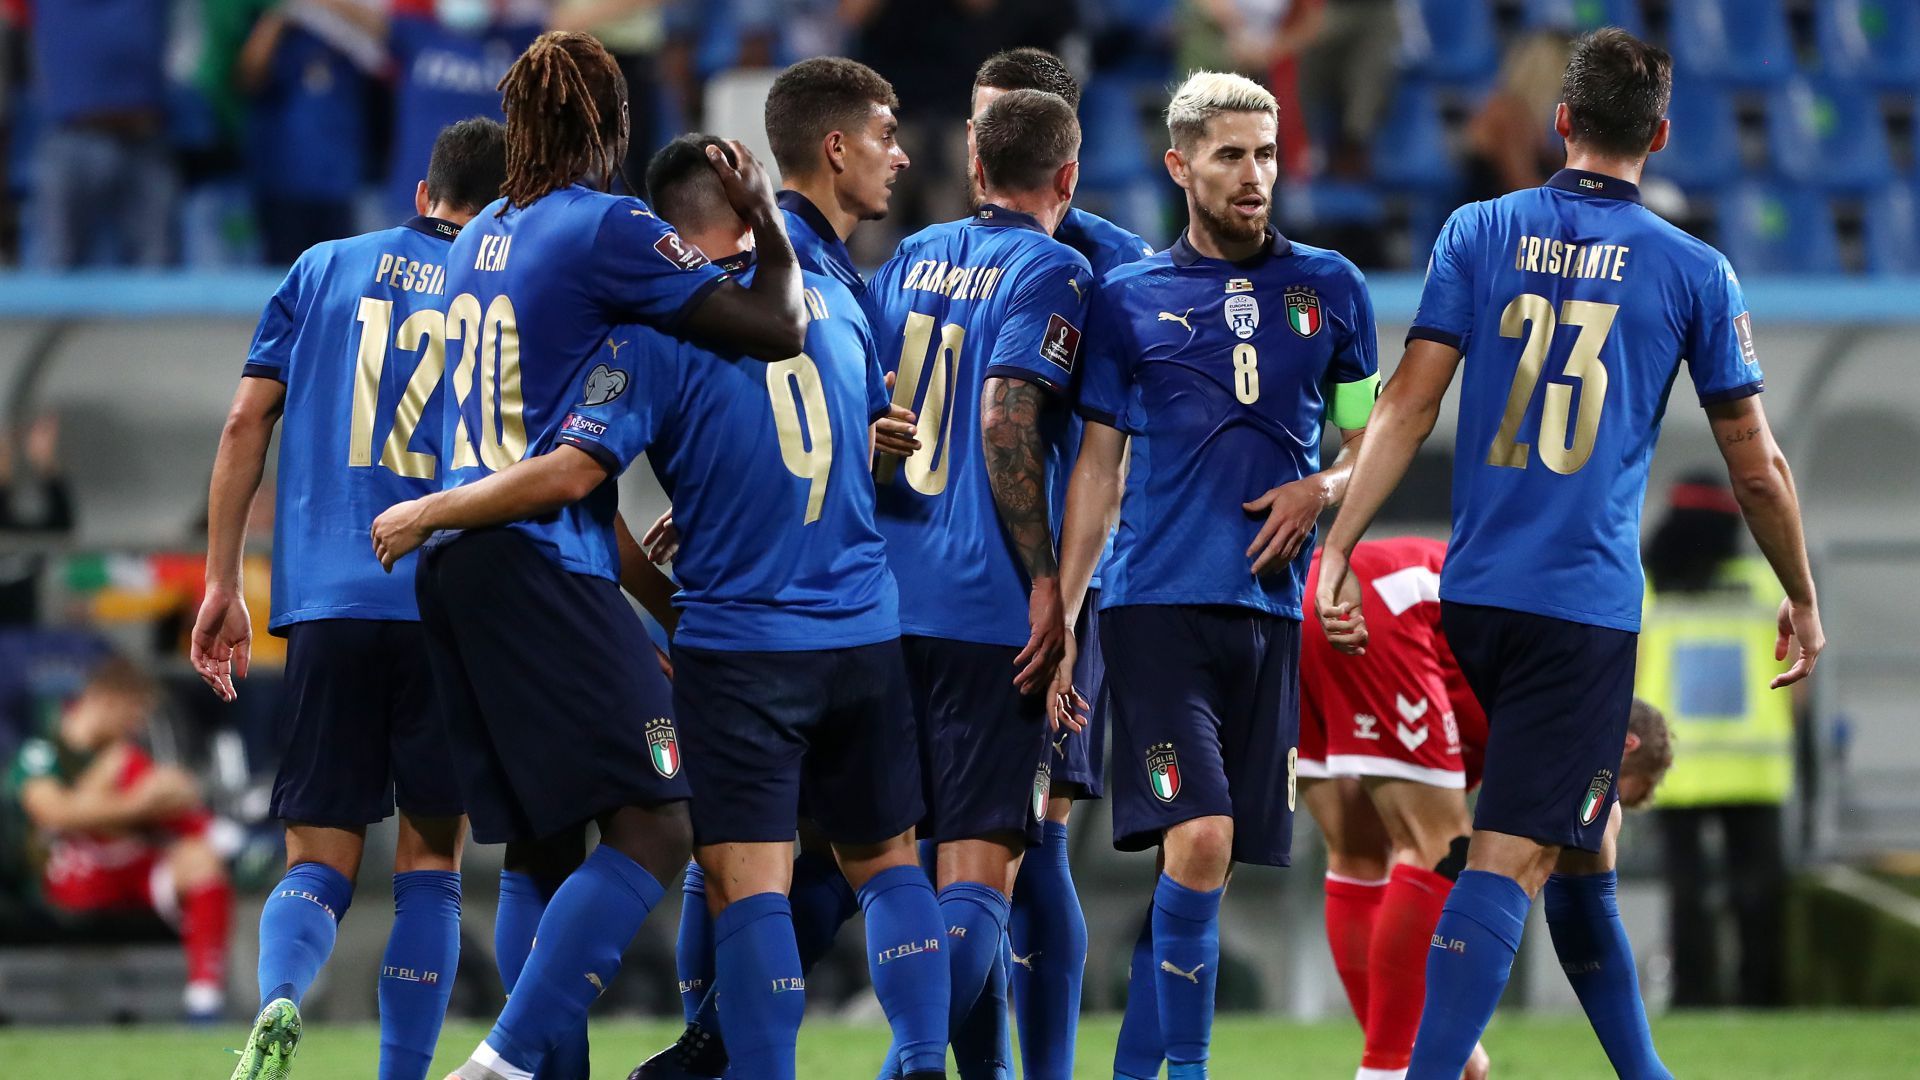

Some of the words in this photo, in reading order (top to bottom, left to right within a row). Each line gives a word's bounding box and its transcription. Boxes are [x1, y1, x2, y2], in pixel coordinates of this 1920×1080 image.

[1515, 236, 1629, 281] CRISTANTE
[1287, 297, 1316, 305] ITALIA
[349, 297, 446, 480] 12
[446, 293, 527, 472] 20
[1233, 342, 1260, 405] 8
[1486, 294, 1620, 474] 23
[571, 417, 607, 435] RESPECT
[876, 310, 966, 496] 10
[766, 352, 832, 526] 9
[650, 731, 673, 741] ITALIA
[1150, 754, 1174, 768] ITALIA
[1287, 746, 1298, 813] 8
[383, 965, 439, 983] ITALIA
[879, 938, 939, 964] ITALIA
